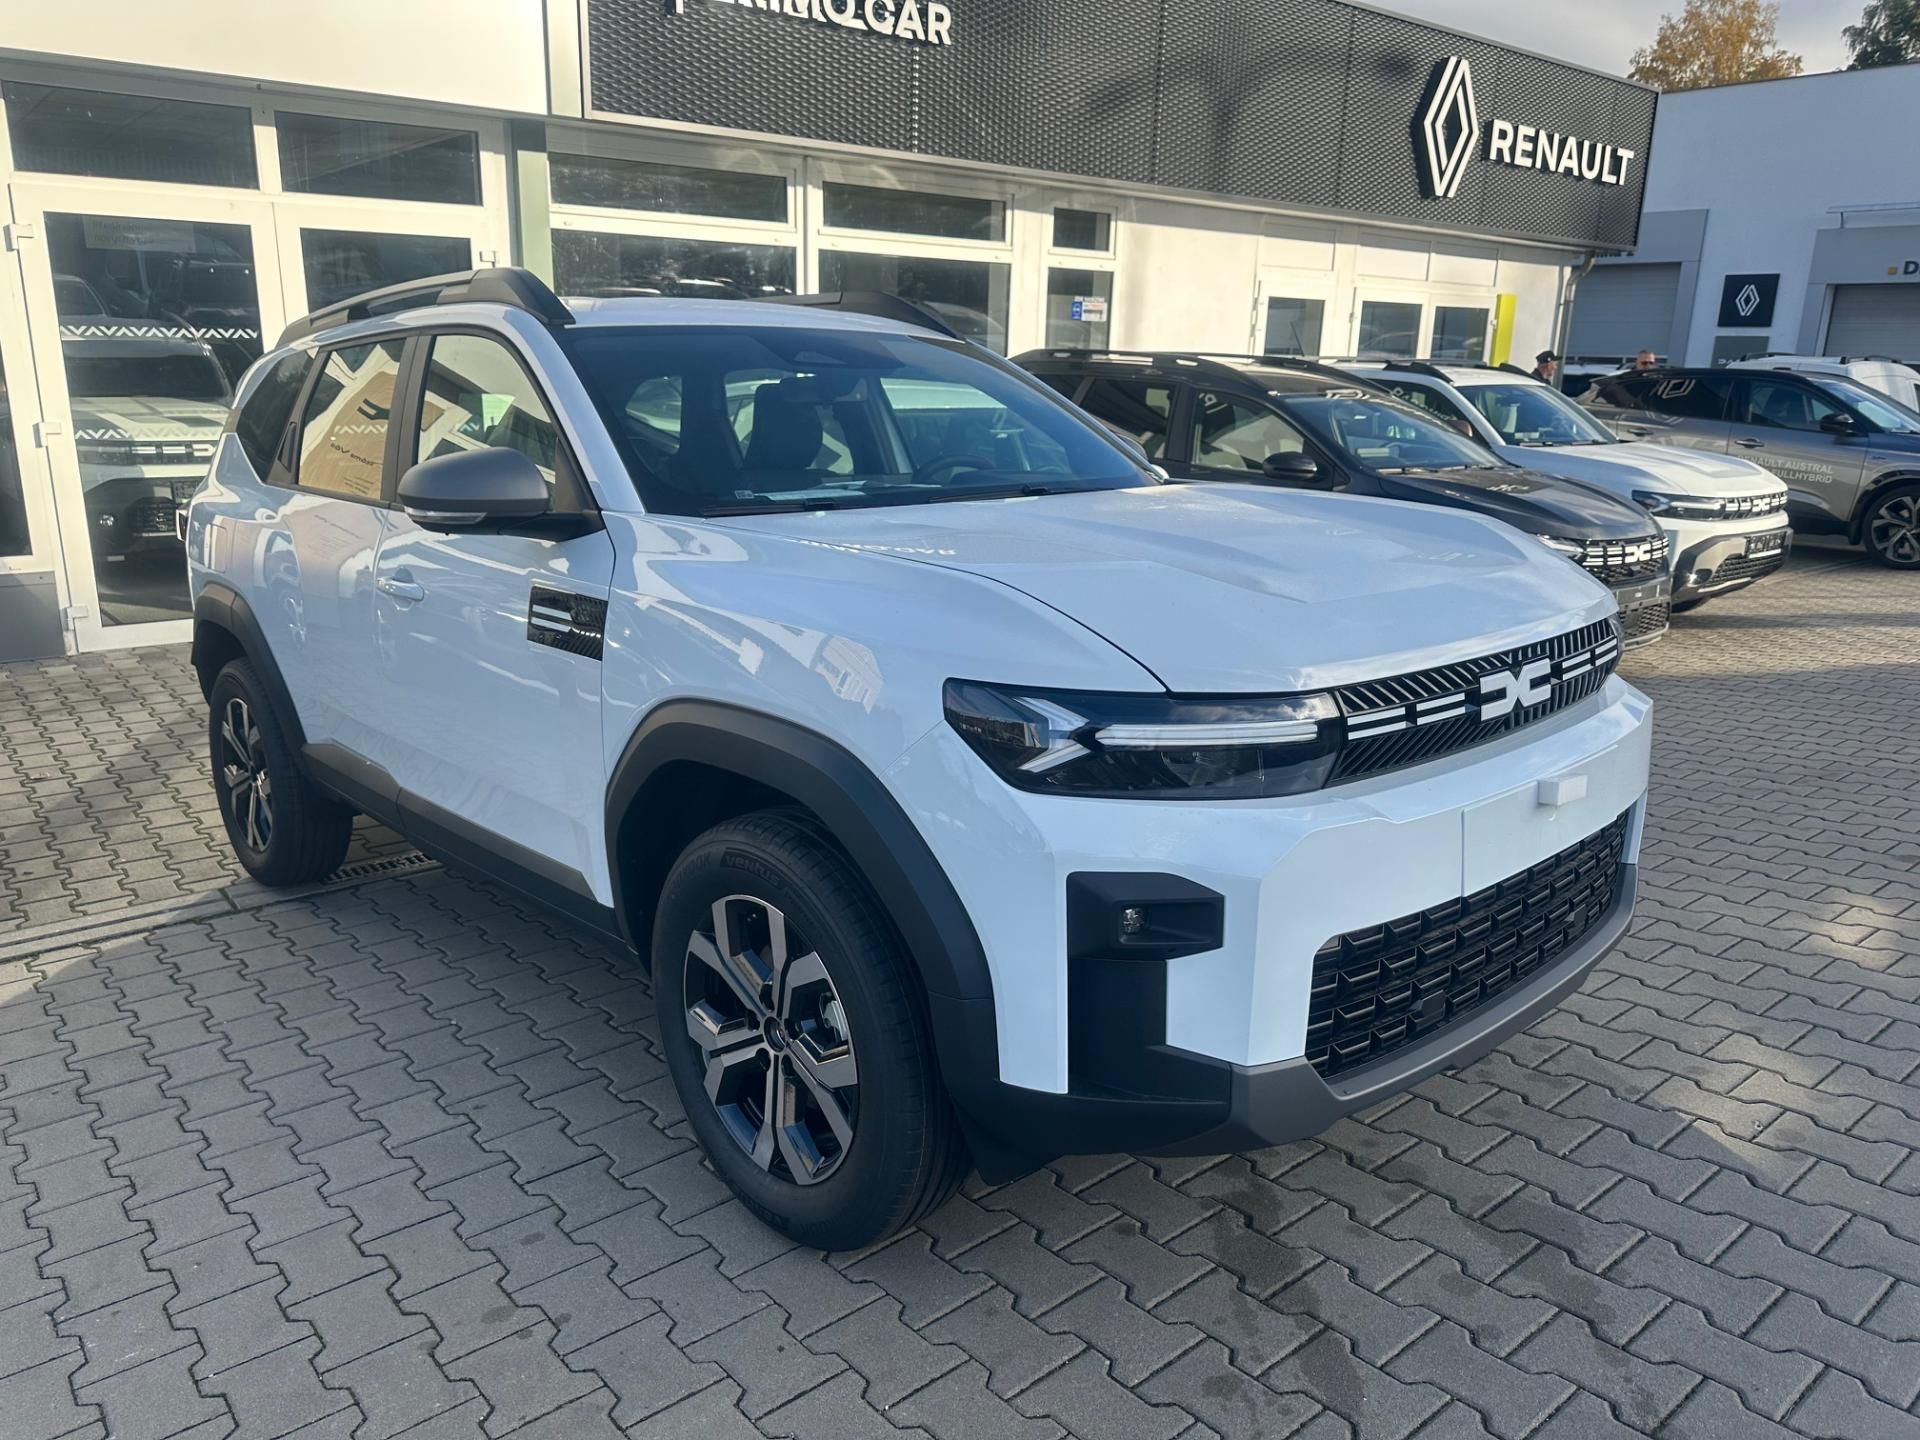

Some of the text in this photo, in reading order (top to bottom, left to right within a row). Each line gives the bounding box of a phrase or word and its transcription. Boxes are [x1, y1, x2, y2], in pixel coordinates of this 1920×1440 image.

[1489, 118, 1635, 187] RENAULT
[1903, 260, 1920, 275] D
[1785, 461, 1834, 474] AUSTRAL
